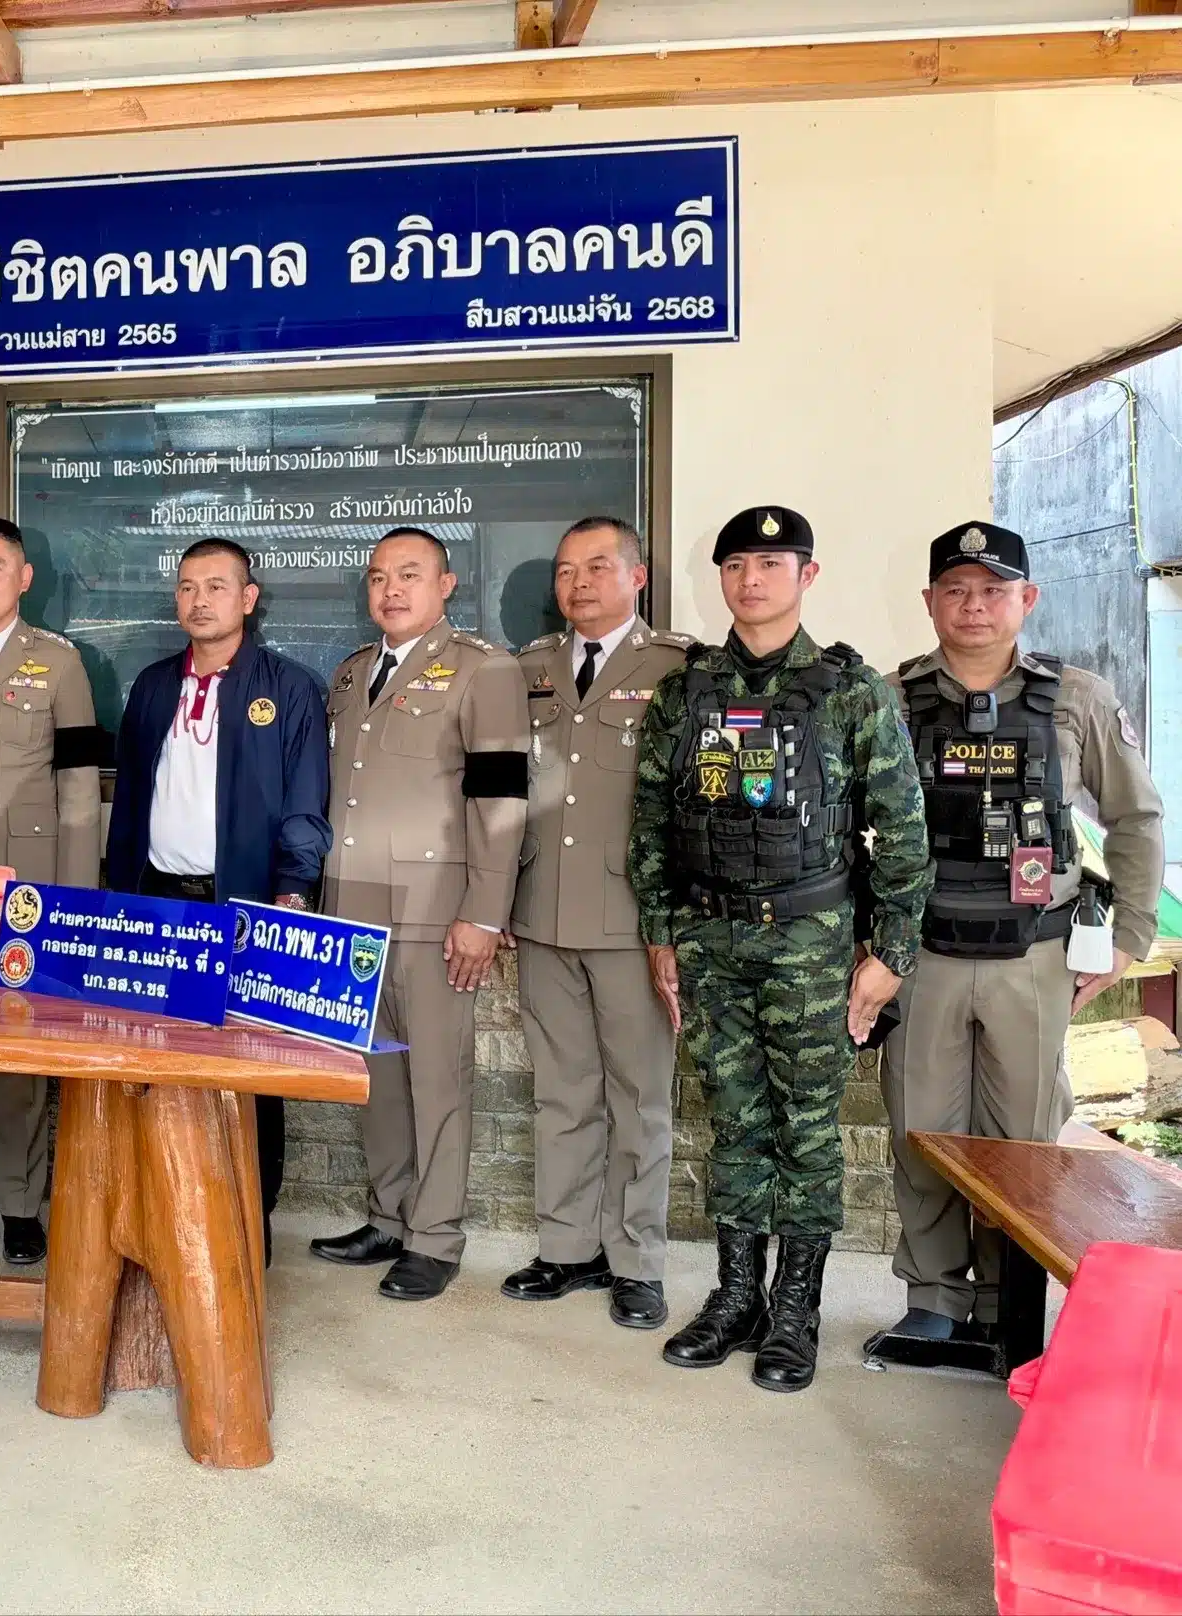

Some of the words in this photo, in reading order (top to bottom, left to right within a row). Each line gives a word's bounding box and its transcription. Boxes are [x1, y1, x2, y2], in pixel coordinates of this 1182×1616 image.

[348, 195, 714, 284] อภิบาลคนดี
[466, 293, 633, 329] สืบสวนแม่จัน
[648, 296, 716, 321] 2568
[118, 323, 177, 346] 2565
[230, 444, 379, 473] เป็นตำรวจมืออาชีพ
[394, 432, 583, 468] ประชาชนเป็นศูนย์กลาง
[330, 487, 473, 519] สร้างขวัญกำลังใจ
[979, 553, 1000, 561] POLICE
[968, 766, 1015, 775] THALAND
[49, 902, 154, 935] ฝ่ายความมั่นคง
[161, 921, 224, 944] อ.แม่จัน
[41, 935, 97, 958] กองร้อย
[103, 946, 189, 971] อส.อ.แม่จัน
[195, 949, 209, 973] ที่
[253, 919, 346, 967] ฉก.ทพ.31
[82, 973, 169, 999] บก.อส.จ.ชร.
